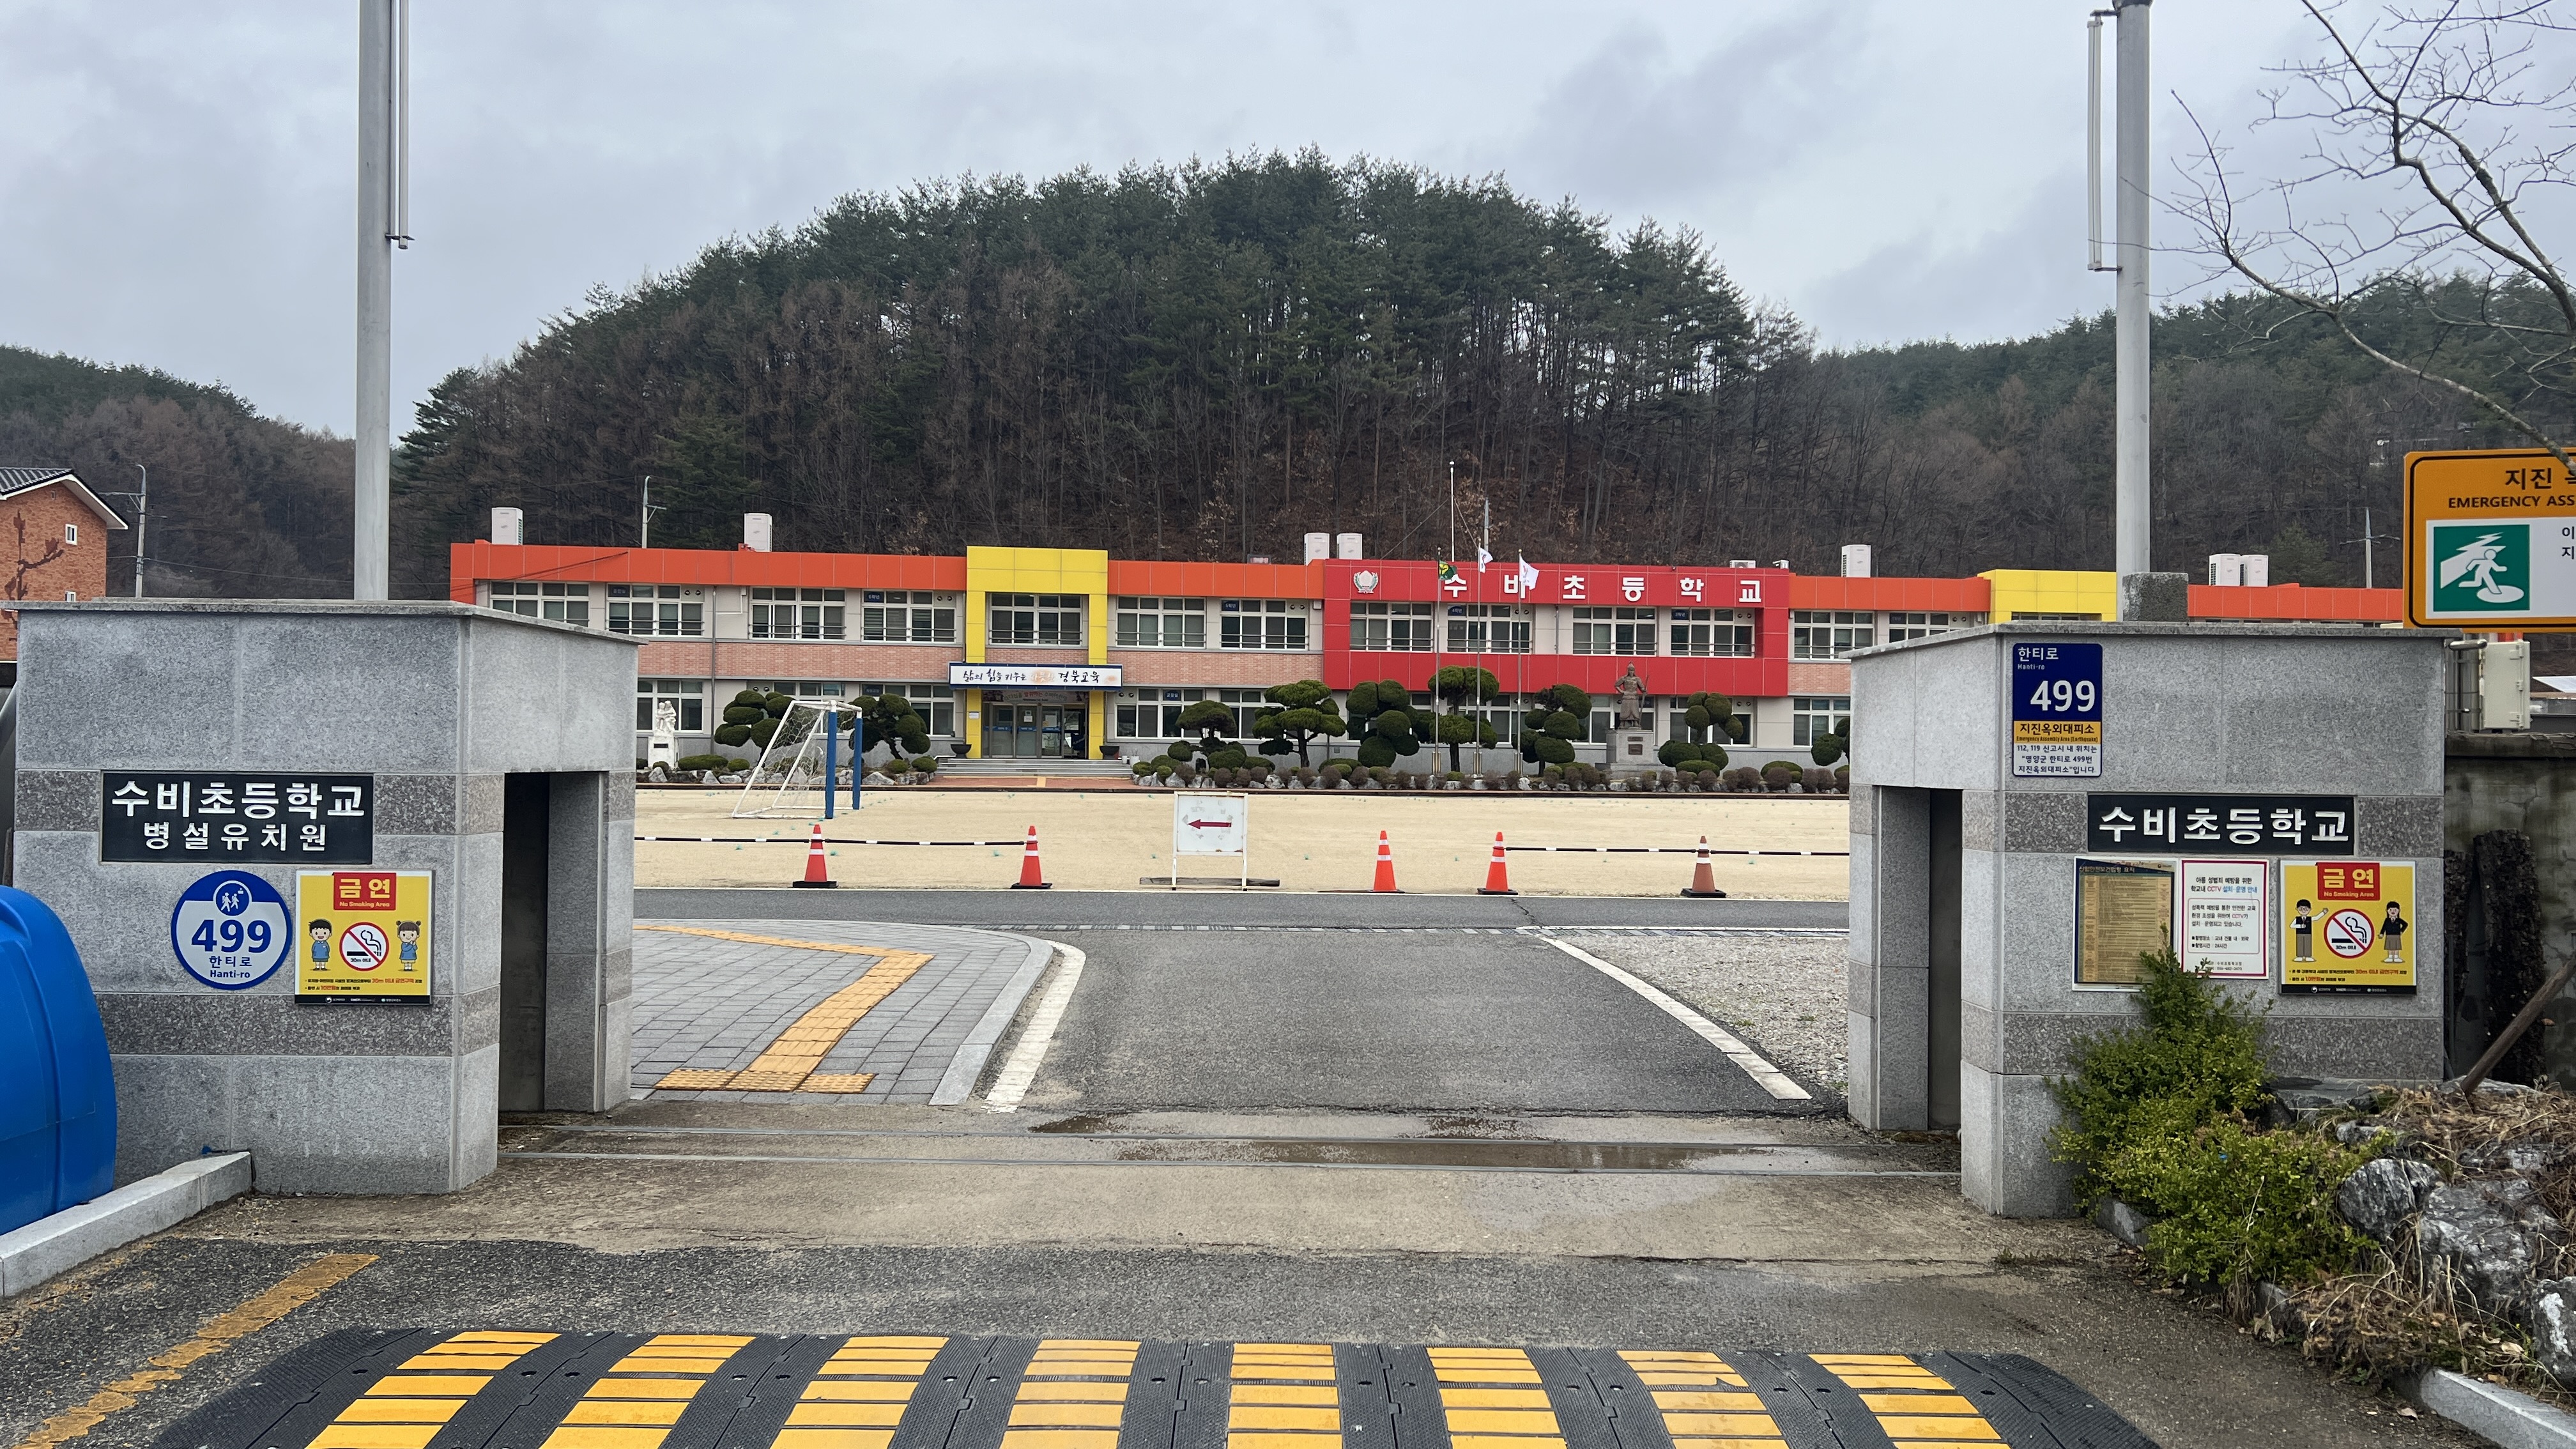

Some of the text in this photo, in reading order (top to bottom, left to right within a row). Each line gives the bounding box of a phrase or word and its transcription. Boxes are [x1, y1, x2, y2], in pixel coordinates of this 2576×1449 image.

[2505, 468, 2552, 490] 지진
[2448, 494, 2575, 509] EMERGENCY ASS
[2018, 647, 2058, 662] 한티로
[963, 670, 983, 682] 삶의
[986, 668, 1002, 682] 힘을
[1058, 670, 1100, 684] 경북교육
[2030, 680, 2096, 712] 499
[2020, 723, 2095, 735] 지진옥외대피소
[2076, 745, 2097, 753] 위치는
[112, 781, 365, 819] 수비초등학교
[2099, 806, 2349, 845] 수비초등학교
[144, 822, 326, 852] 병설유치원
[339, 879, 390, 898] 금연
[2323, 869, 2374, 889] 금연
[192, 919, 272, 953] 499
[209, 956, 252, 968] 한티로
[210, 970, 250, 978] Hanti-ro
